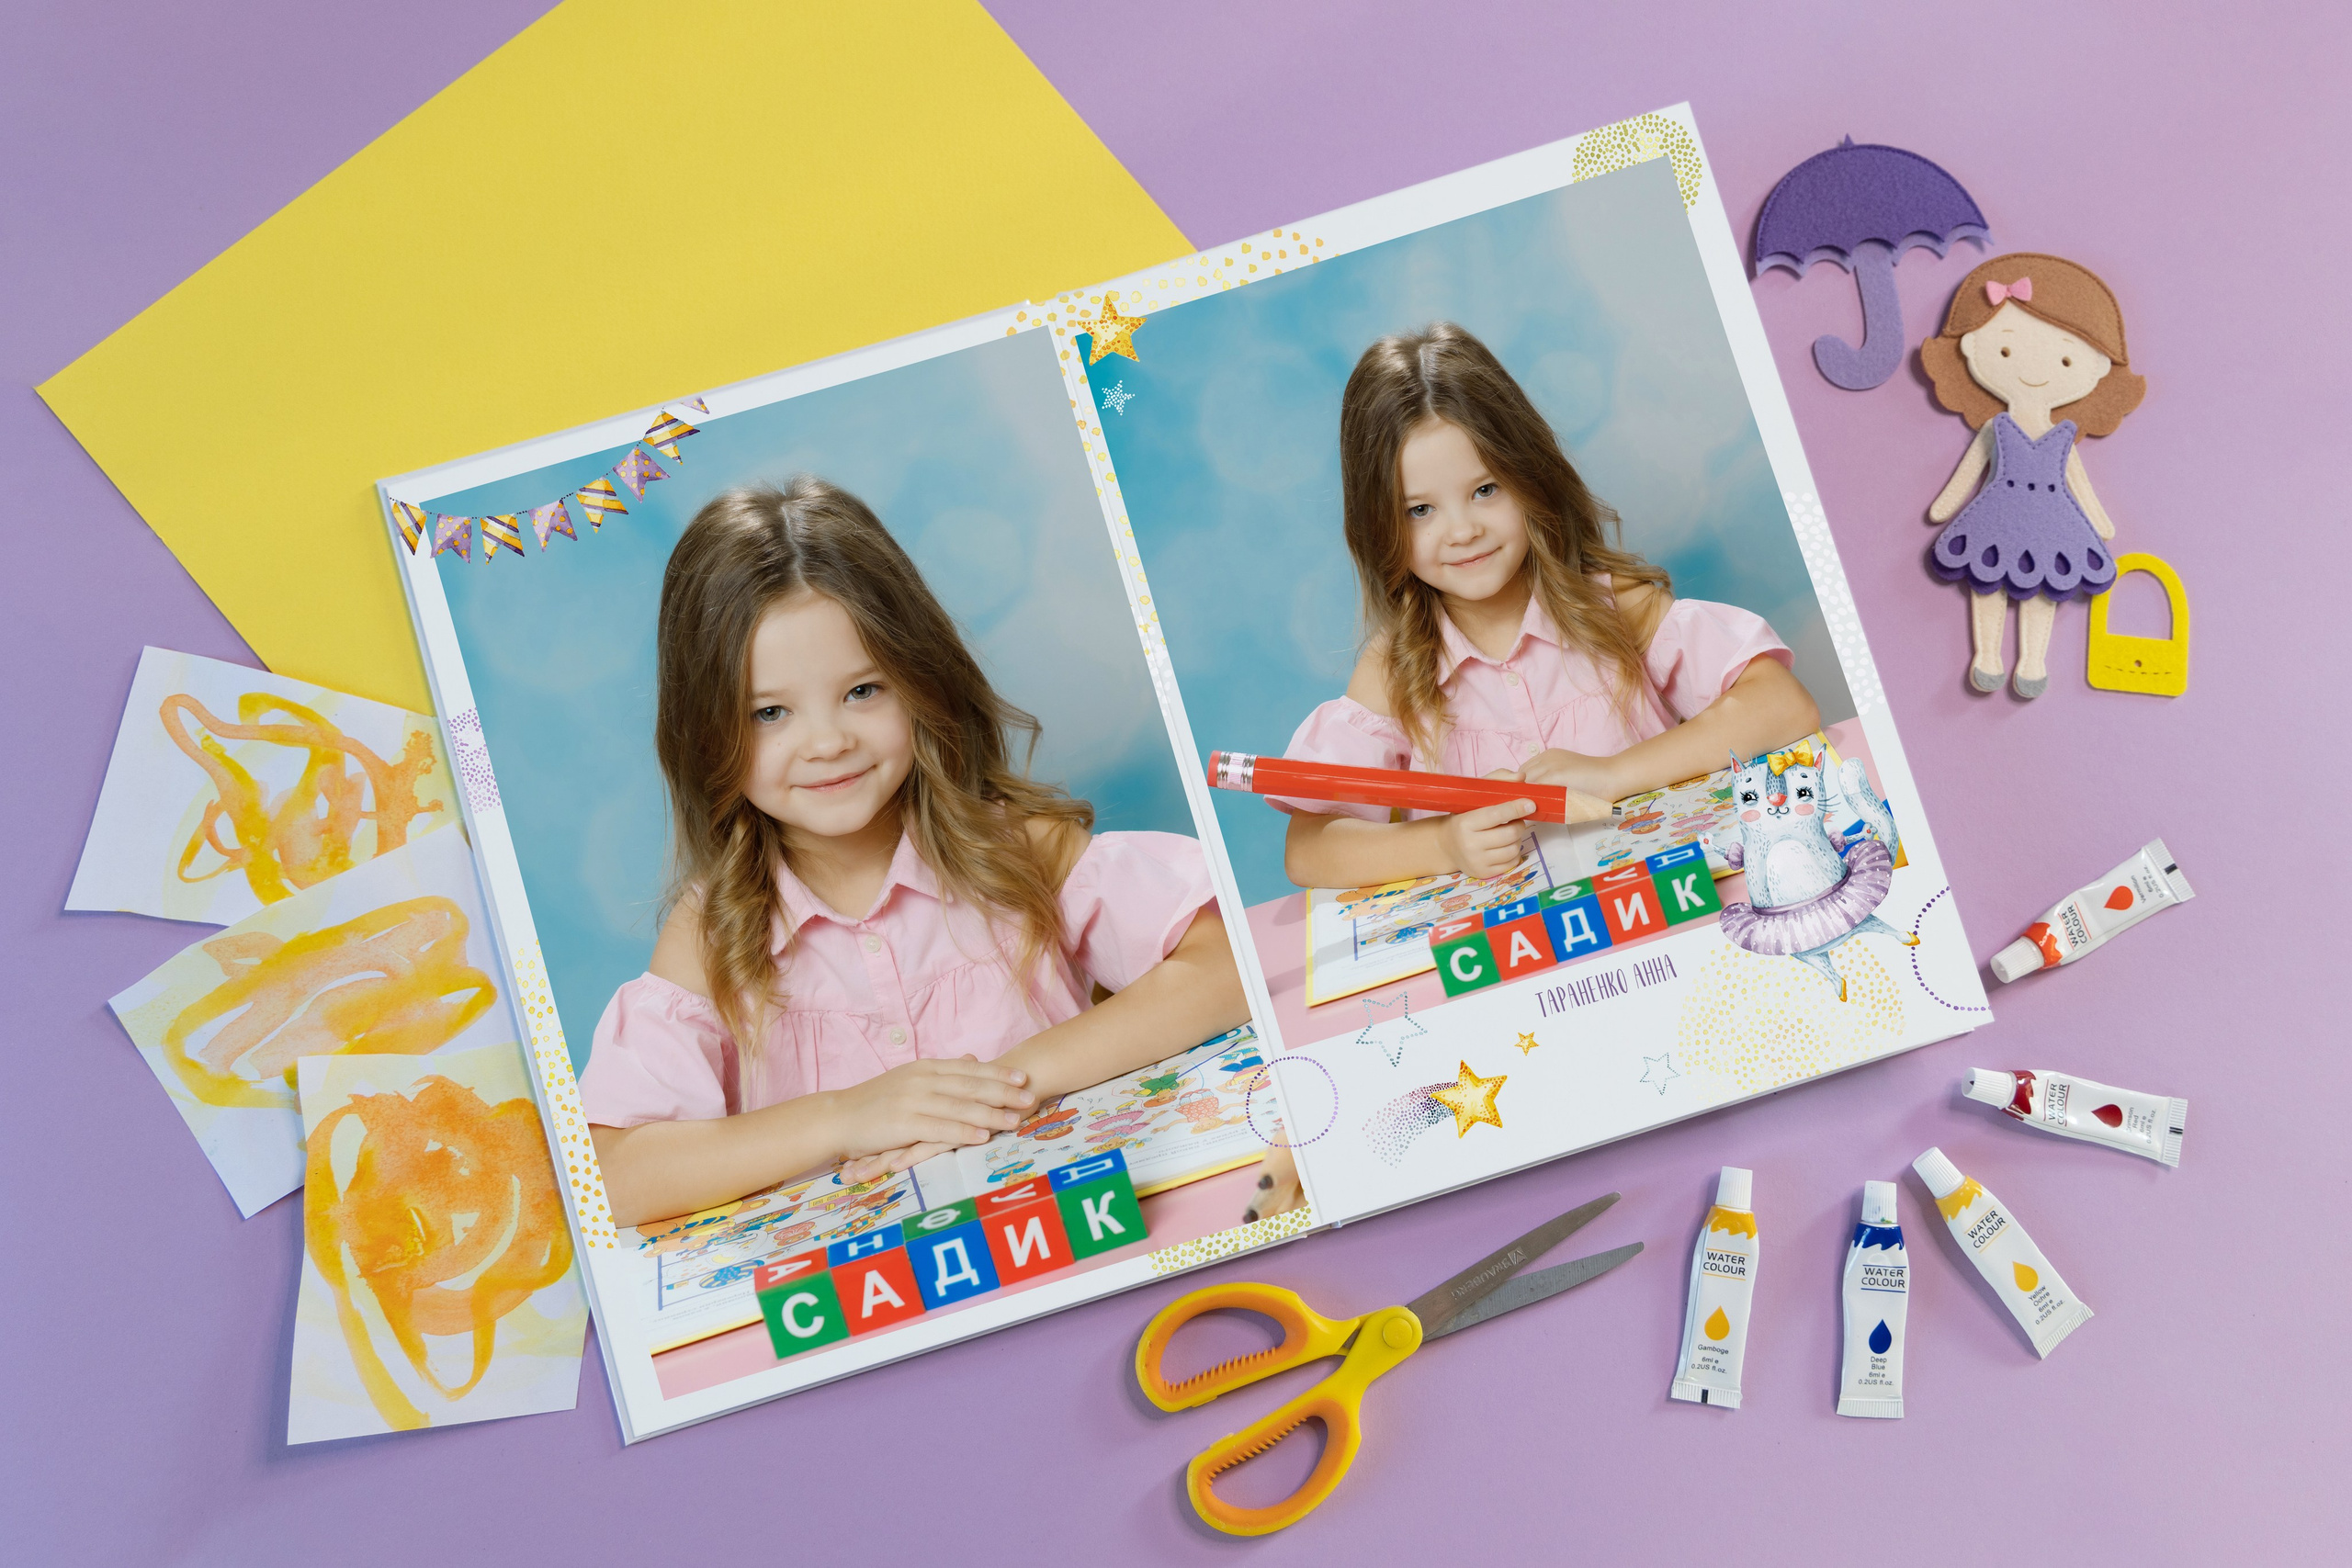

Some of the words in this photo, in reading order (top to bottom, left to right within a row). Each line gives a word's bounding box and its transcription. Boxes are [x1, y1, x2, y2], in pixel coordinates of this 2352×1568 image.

[1449, 873, 1706, 983] САДИК
[2061, 910, 2078, 947] WATER
[2067, 905, 2087, 944] COLOUR
[1534, 967, 1629, 1018] ТАРАНЕНКО
[1633, 953, 1678, 988] АННА
[2048, 1083, 2058, 1121] WATER
[2057, 1084, 2067, 1125] COLOUR
[1967, 1210, 1998, 1239] WATER
[1973, 1217, 2007, 1248] COLOUR
[781, 1190, 1126, 1338] САДИК
[1702, 1261, 1746, 1276] COLOUR
[1706, 1251, 1746, 1266] WATER
[1861, 1277, 1905, 1289] COLOUR
[1864, 1267, 1904, 1278] WATER
[2028, 1285, 2046, 1301] Yellow
[2033, 1292, 2050, 1306] Ochre
[2038, 1302, 2049, 1313] 6ml
[1697, 1344, 1729, 1355] Gamboge
[1870, 1356, 1887, 1364] Deep
